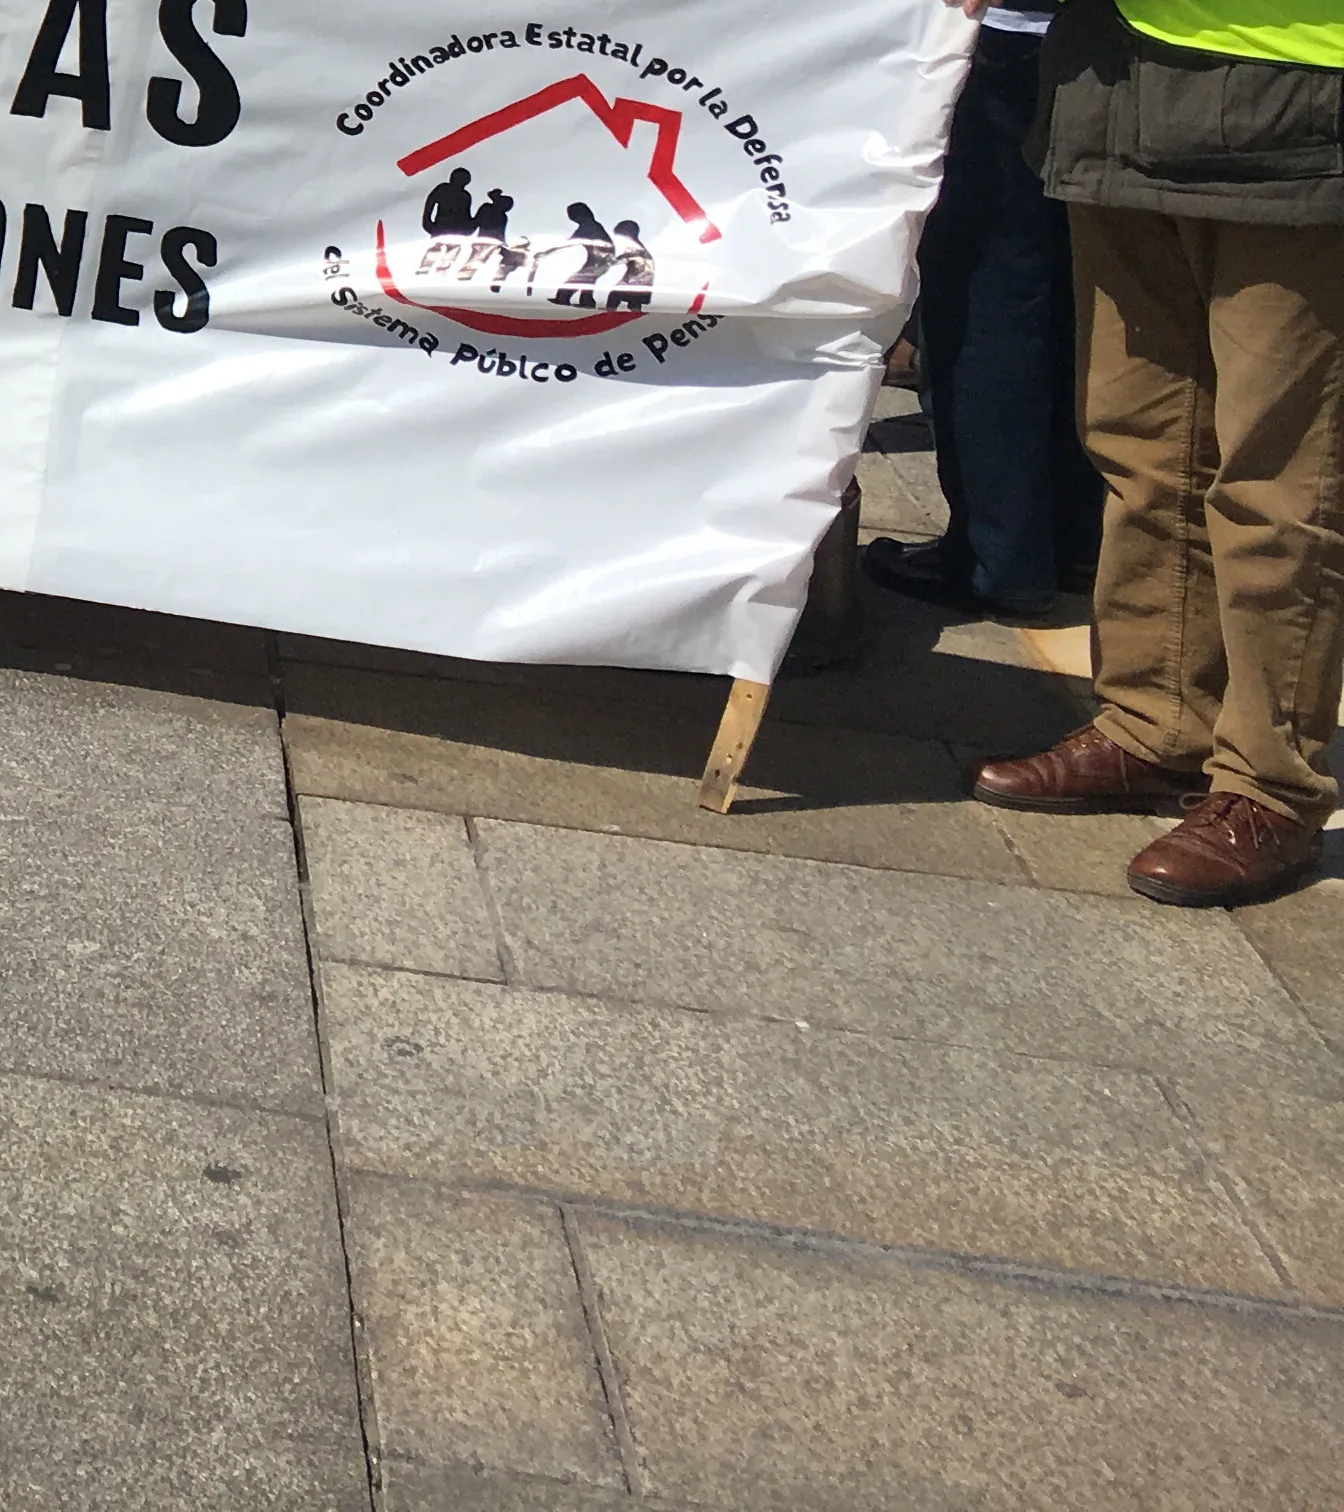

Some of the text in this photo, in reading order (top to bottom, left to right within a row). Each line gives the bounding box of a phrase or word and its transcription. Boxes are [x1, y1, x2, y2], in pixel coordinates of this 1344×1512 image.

[336, 22, 792, 227] Coordinadora Estatal por la Defensa
[330, 286, 439, 359] Sistema
[594, 350, 637, 377] de
